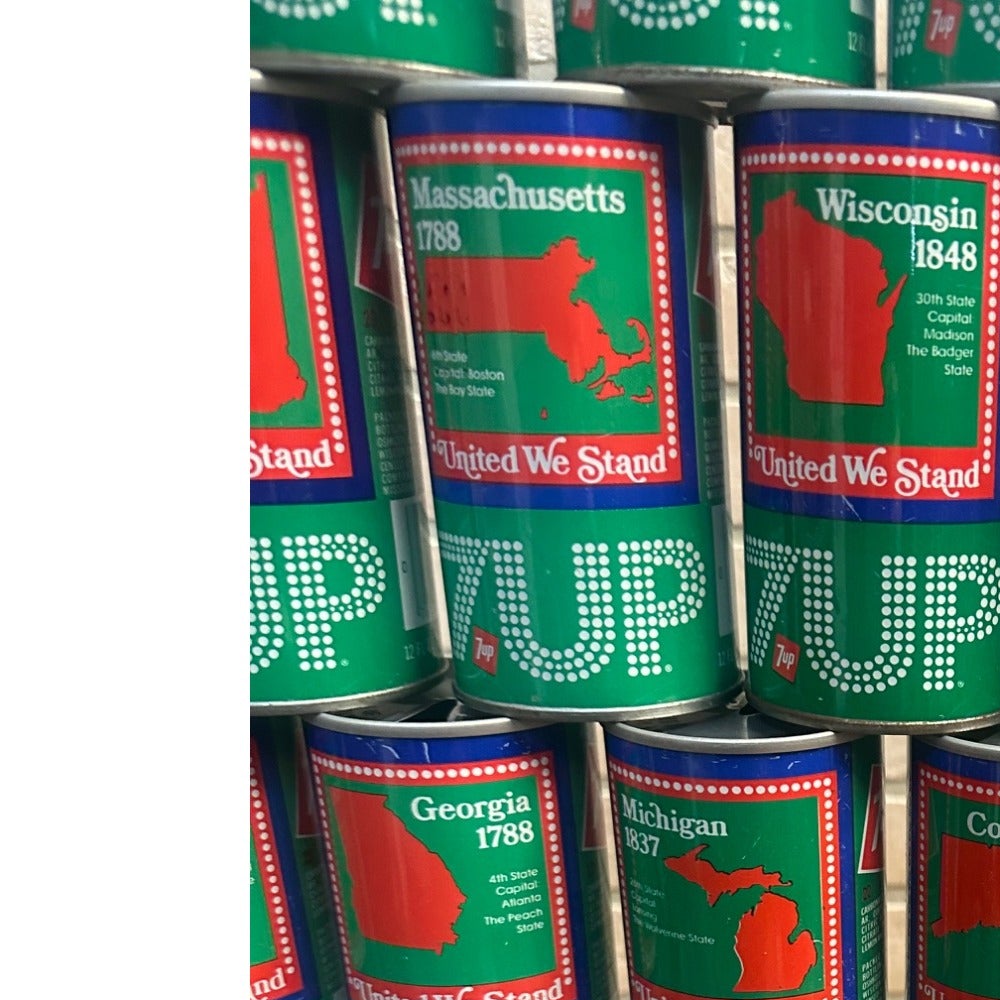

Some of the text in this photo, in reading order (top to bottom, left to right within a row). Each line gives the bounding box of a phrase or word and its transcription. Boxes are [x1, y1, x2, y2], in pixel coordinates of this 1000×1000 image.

[410, 174, 626, 215] Massachusetts
[816, 187, 978, 233] Wisconsin
[416, 221, 461, 252] 1788
[915, 238, 978, 272] 1848
[915, 292, 976, 308] 30th State
[923, 328, 974, 342] Madison
[906, 343, 974, 360] The Badger
[468, 368, 505, 381] Boston
[944, 364, 974, 377] State
[467, 385, 496, 398] State
[436, 436, 668, 484] United We Stand
[753, 445, 980, 498] United We Stand
[438, 530, 706, 683] 7UP
[474, 636, 494, 660] 7up
[775, 645, 796, 670] 7up
[410, 791, 532, 823] Georgia
[621, 792, 729, 840] Michigan
[475, 820, 536, 851] 1788
[624, 826, 661, 858] 1837
[489, 869, 538, 885] 4th State
[501, 894, 542, 909] Atlanta
[484, 908, 544, 927] The Peach
[517, 921, 545, 934] State
[688, 933, 716, 945] State
